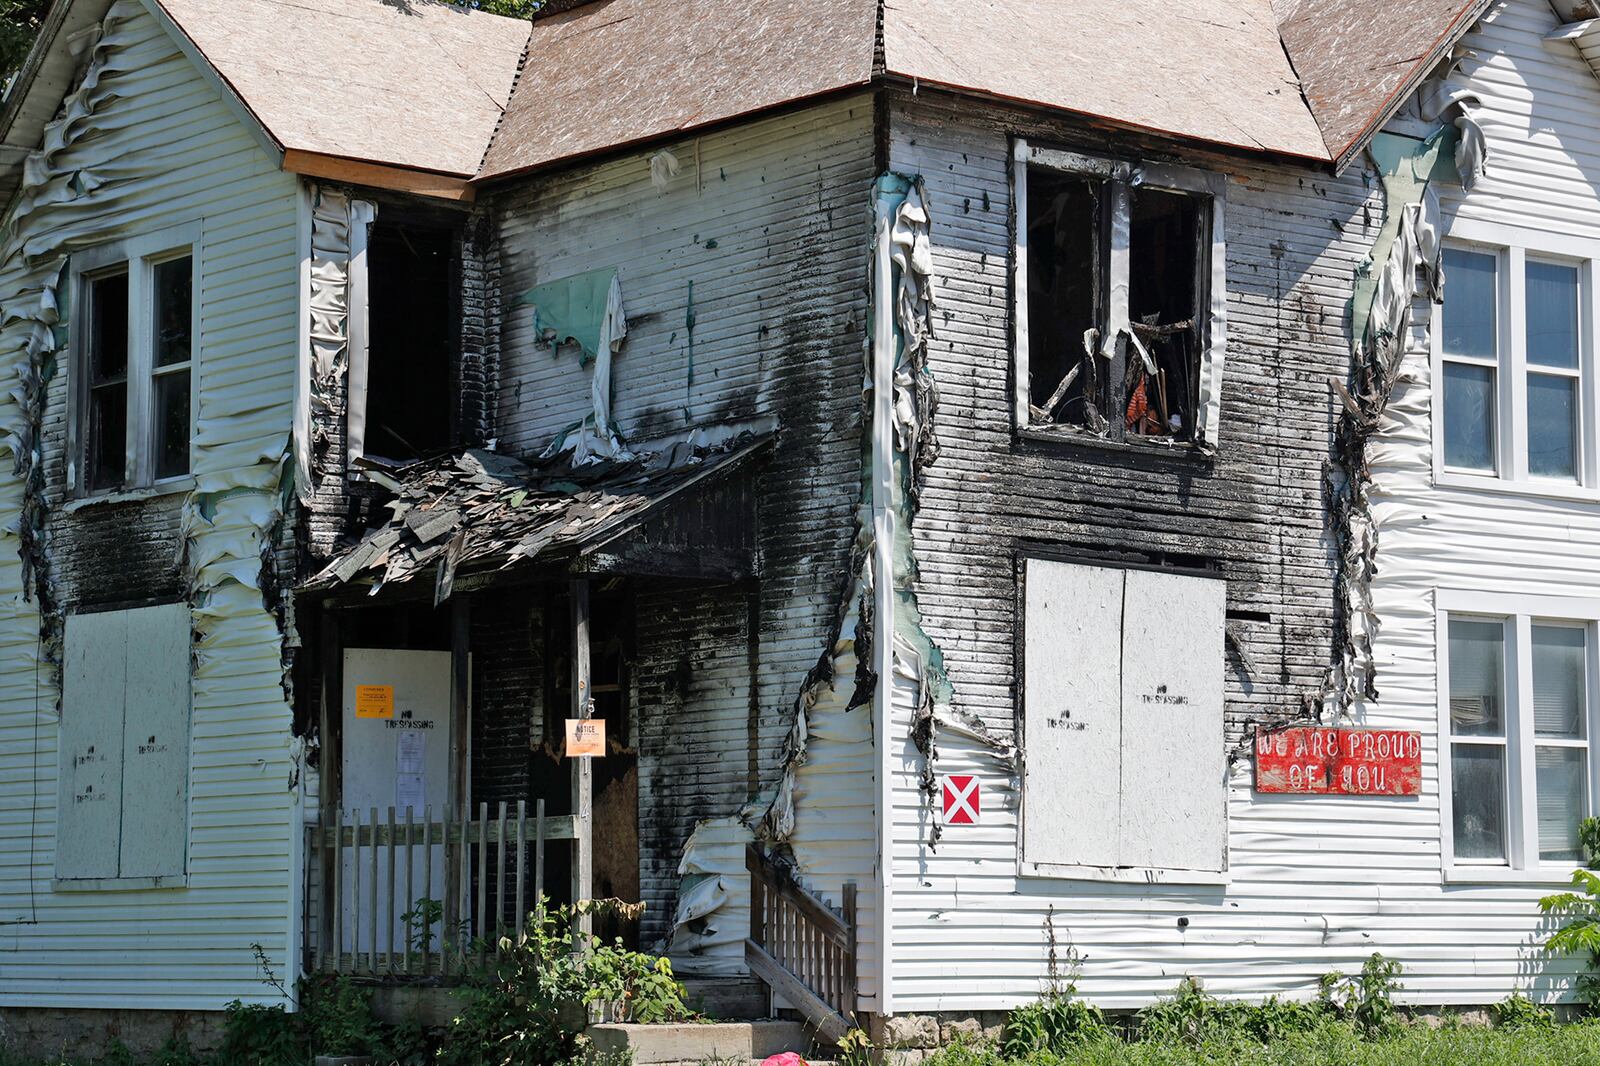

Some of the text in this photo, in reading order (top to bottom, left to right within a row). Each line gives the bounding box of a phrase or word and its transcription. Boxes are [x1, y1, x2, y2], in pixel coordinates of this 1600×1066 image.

[1156, 685, 1167, 694] NO
[401, 710, 413, 719] NO
[1060, 709, 1070, 719] NO
[385, 719, 434, 729] TRESPASSING
[1258, 731, 1421, 760] WE ARE PROUD
[1289, 763, 1386, 791] OF YOU
